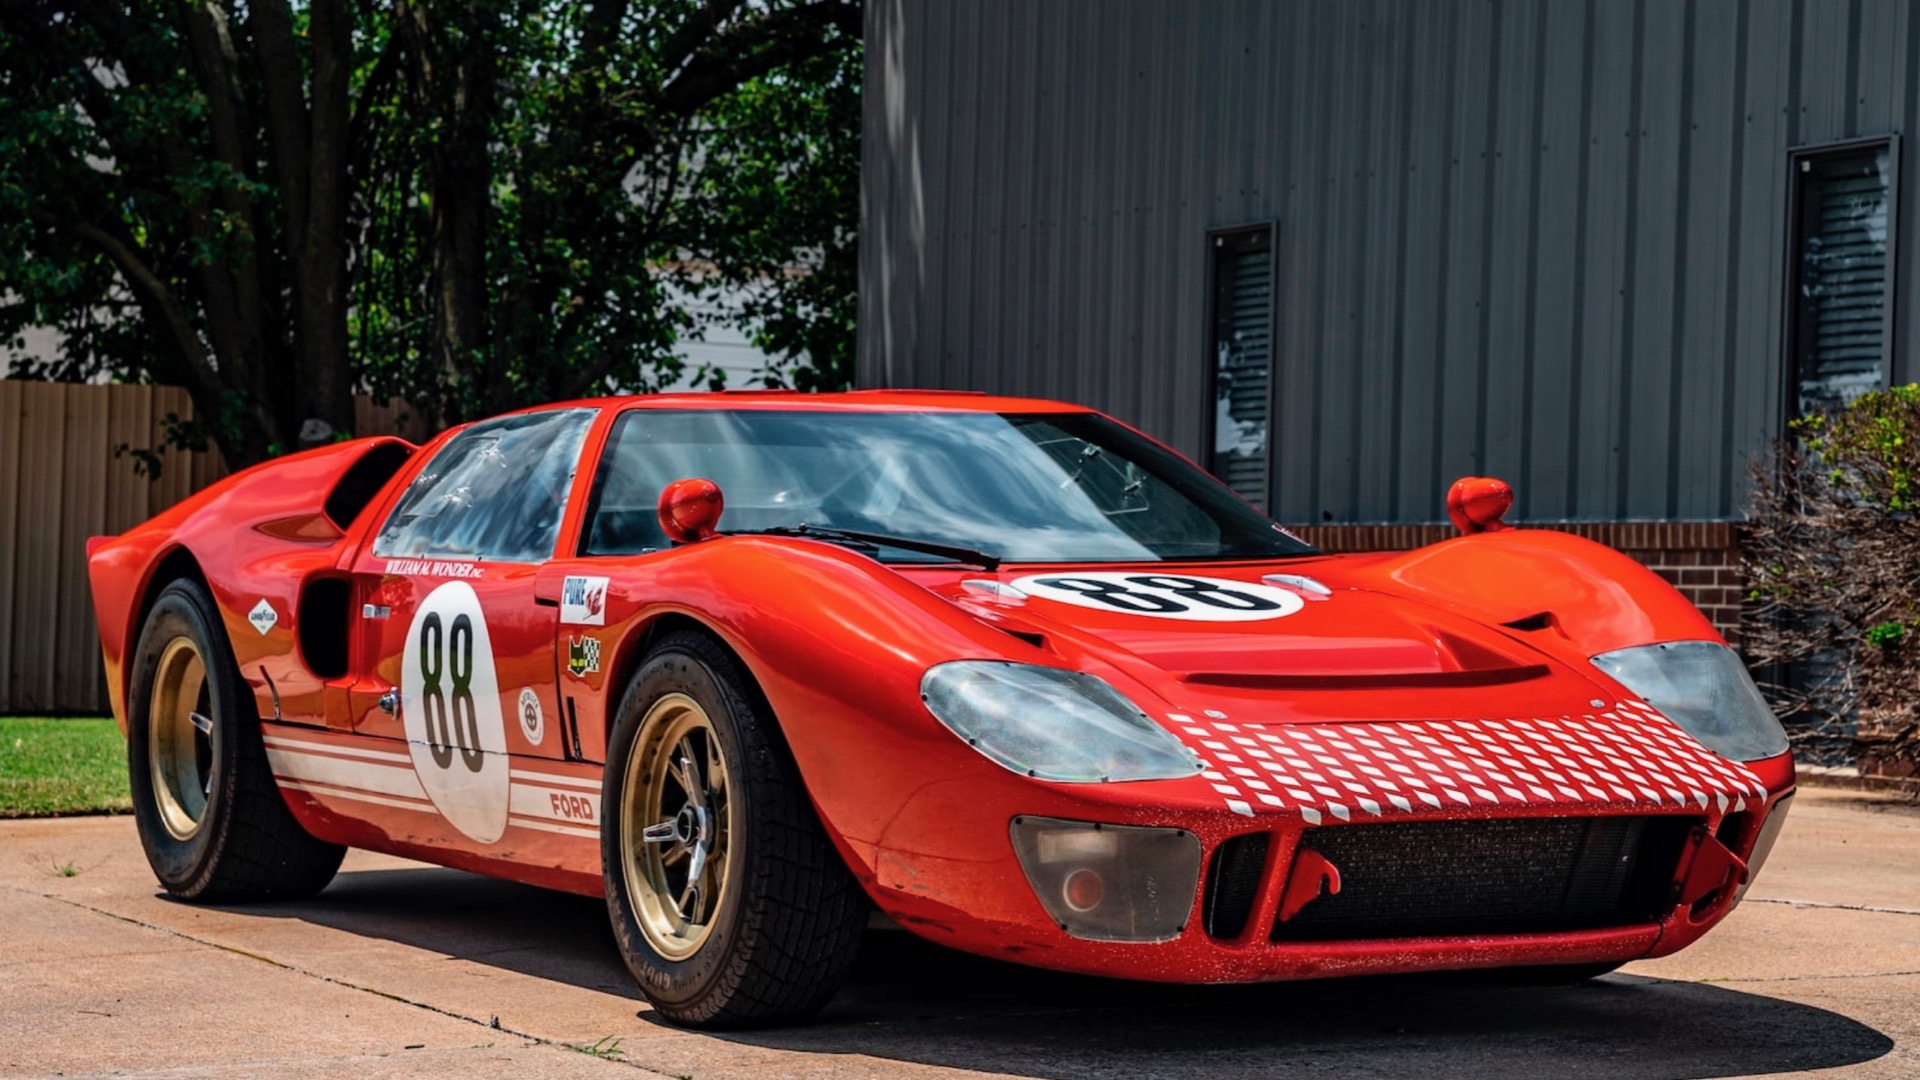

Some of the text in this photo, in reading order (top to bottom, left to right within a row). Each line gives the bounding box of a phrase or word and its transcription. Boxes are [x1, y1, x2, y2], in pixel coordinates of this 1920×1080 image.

[385, 560, 423, 575] WILLIAM
[432, 562, 475, 577] WONDER
[563, 578, 588, 606] PURE
[1033, 576, 1282, 613] 88
[420, 611, 484, 773] 88
[549, 793, 594, 820] FORD
